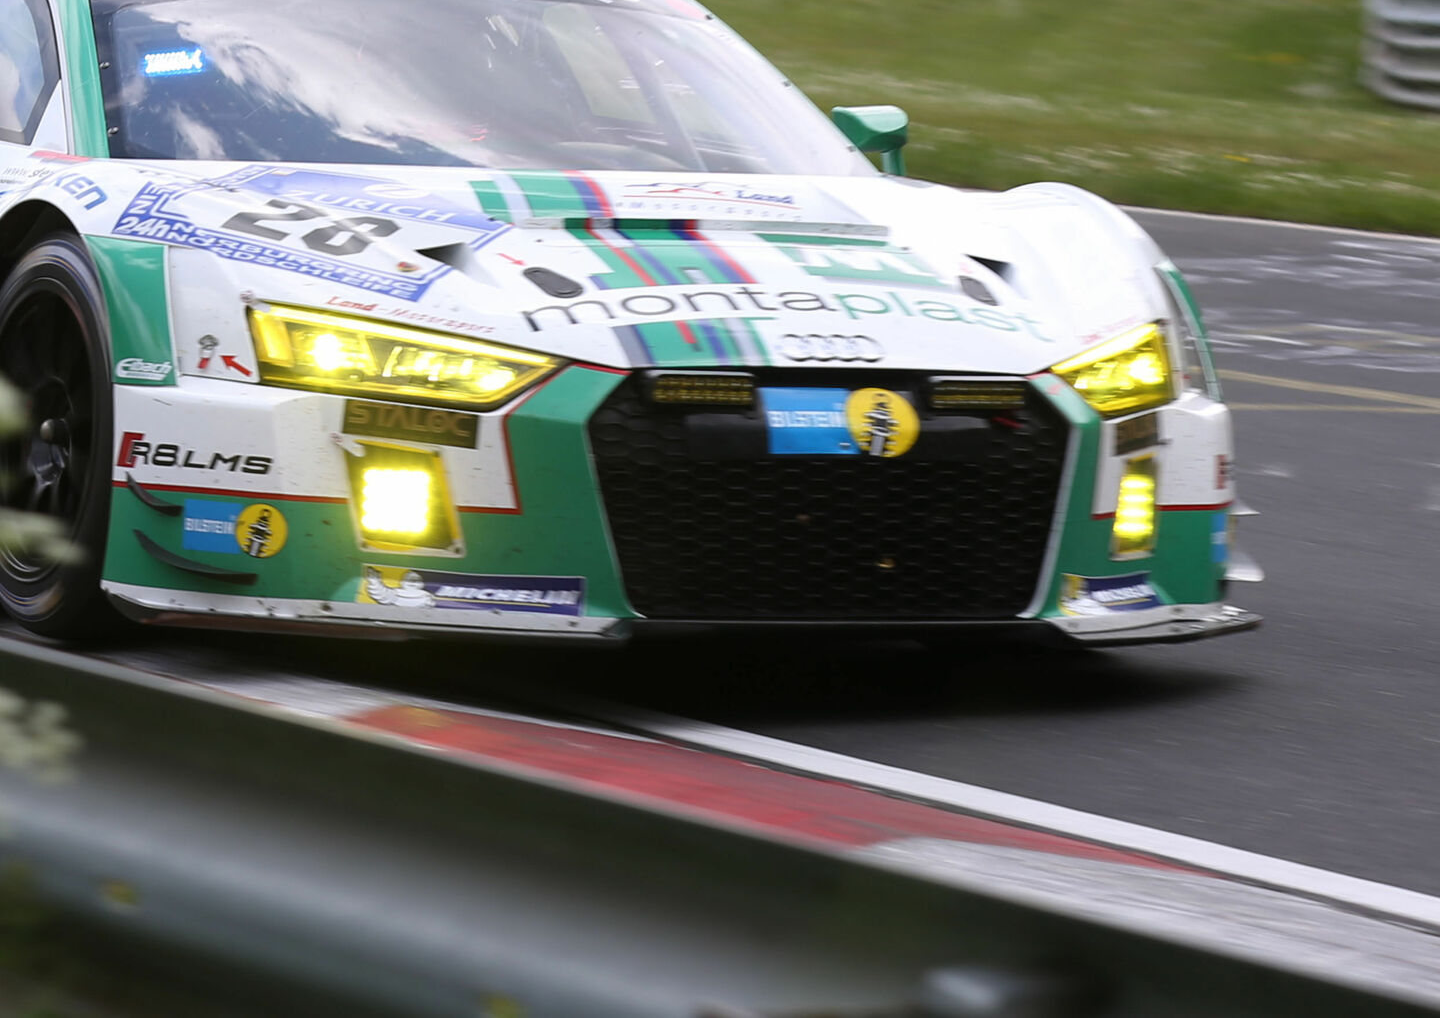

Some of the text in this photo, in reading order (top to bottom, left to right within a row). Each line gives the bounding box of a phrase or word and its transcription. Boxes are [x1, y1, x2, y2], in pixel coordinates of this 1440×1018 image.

[281, 189, 458, 222] ZURICH
[115, 216, 172, 240] 24h
[222, 199, 402, 257] 28
[522, 285, 1055, 343] montaplast
[348, 400, 471, 438] STALOC
[434, 584, 581, 606] MICHELIN
